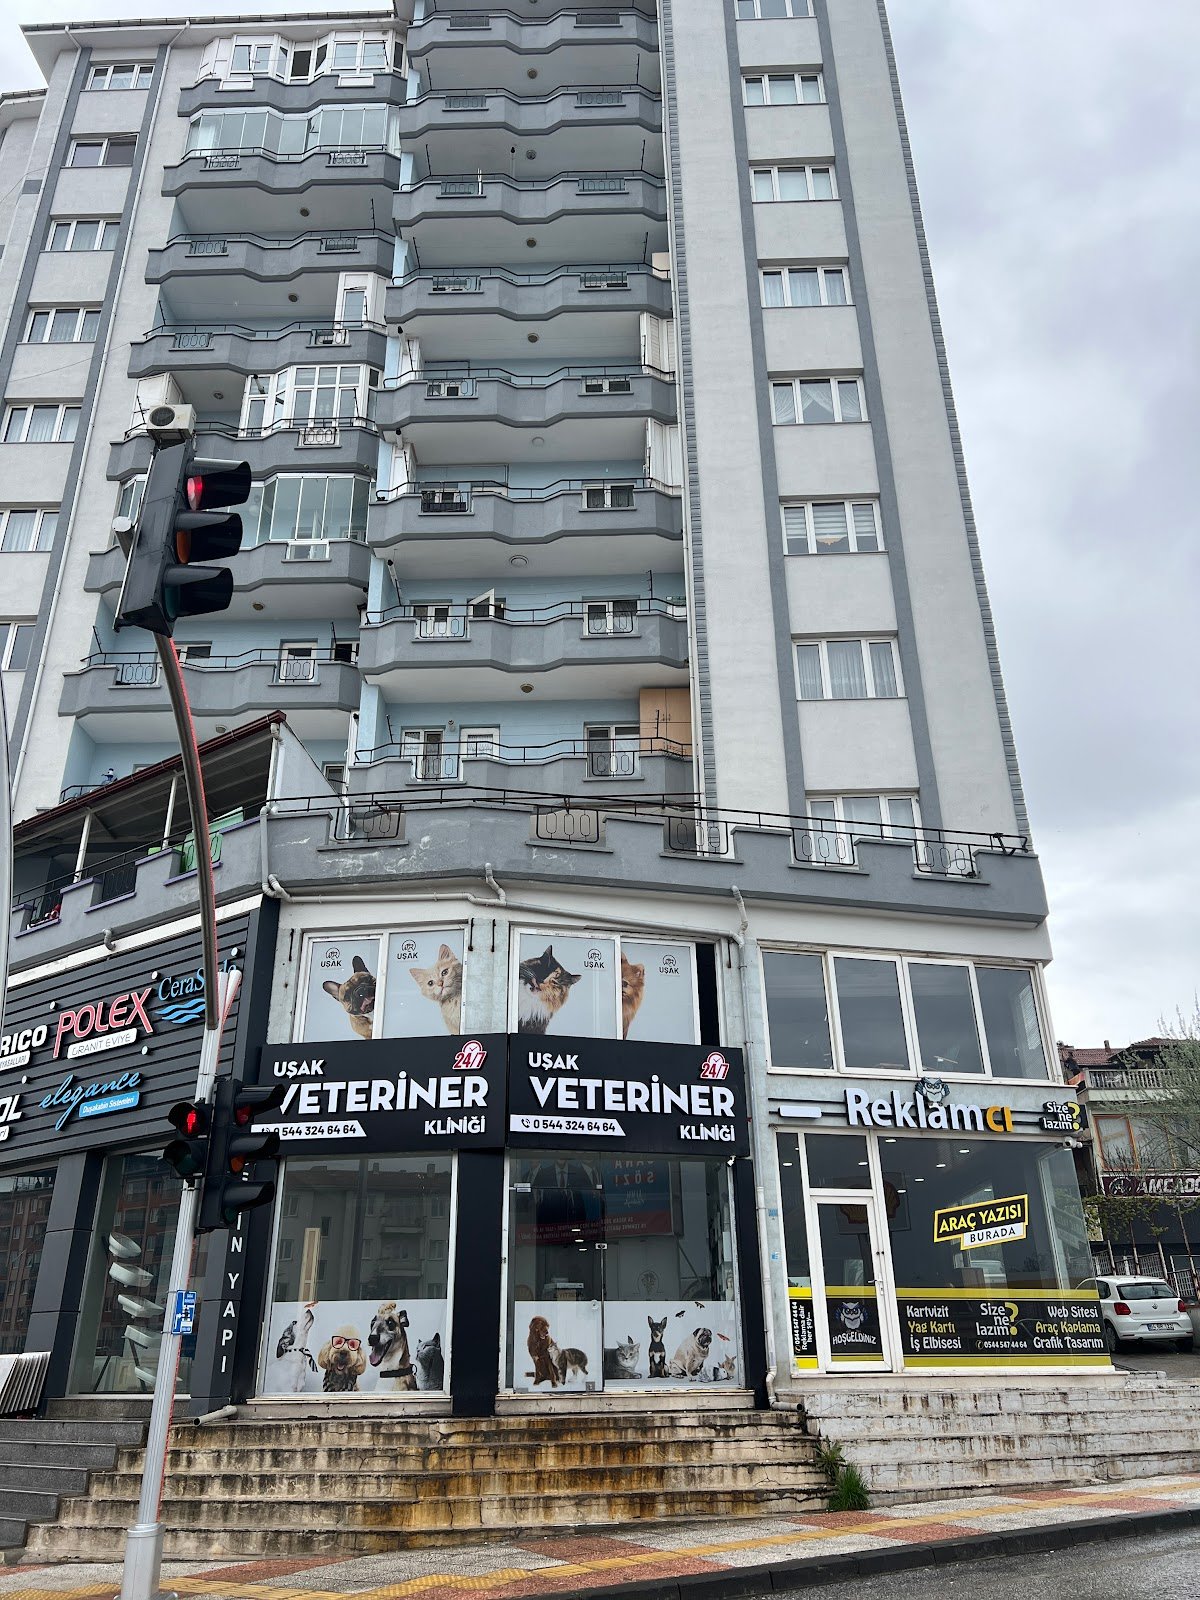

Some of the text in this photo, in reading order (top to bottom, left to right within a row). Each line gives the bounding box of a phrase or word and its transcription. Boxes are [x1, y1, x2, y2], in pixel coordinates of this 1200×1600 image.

[53, 987, 153, 1058] POLEX
[273, 1059, 325, 1078] UŞAK
[453, 1051, 487, 1069] 24/7
[528, 1051, 579, 1070] UŞAK
[700, 1062, 729, 1080] 24/7
[39, 1072, 141, 1131] elegance
[280, 1070, 489, 1115] VETERİNER
[529, 1074, 736, 1117] VETERİNER
[845, 1087, 1014, 1133] Reklamcı
[1047, 1101, 1069, 1113] Size
[424, 1115, 486, 1135] KLİNİĞİ
[533, 1119, 616, 1132] 0 544 324 64 64
[1059, 1113, 1073, 1121] ne
[282, 1126, 302, 1136] 544
[305, 1125, 325, 1136] 324
[327, 1124, 341, 1135] 64
[343, 1124, 357, 1134] 64
[680, 1123, 736, 1142] KLİNİĞİ
[939, 1203, 1022, 1233] ARAÇ YAZISI
[970, 1226, 1016, 1243] BURADA
[906, 1305, 949, 1318] Kartvizit
[980, 1302, 1006, 1316] Size
[1047, 1306, 1098, 1318] Web Sitesi
[221, 1272, 240, 1373] YAPI
[930, 1321, 956, 1333] Kartı
[994, 1315, 1010, 1326] ne
[1036, 1321, 1101, 1335] Araç Kaplama
[800, 1319, 808, 1350] Reklama
[910, 1334, 962, 1352] İş Elbisesi
[1033, 1336, 1104, 1349] Grafik Tasarım
[984, 1341, 999, 1349] 0544
[1000, 1341, 1010, 1349] 547
